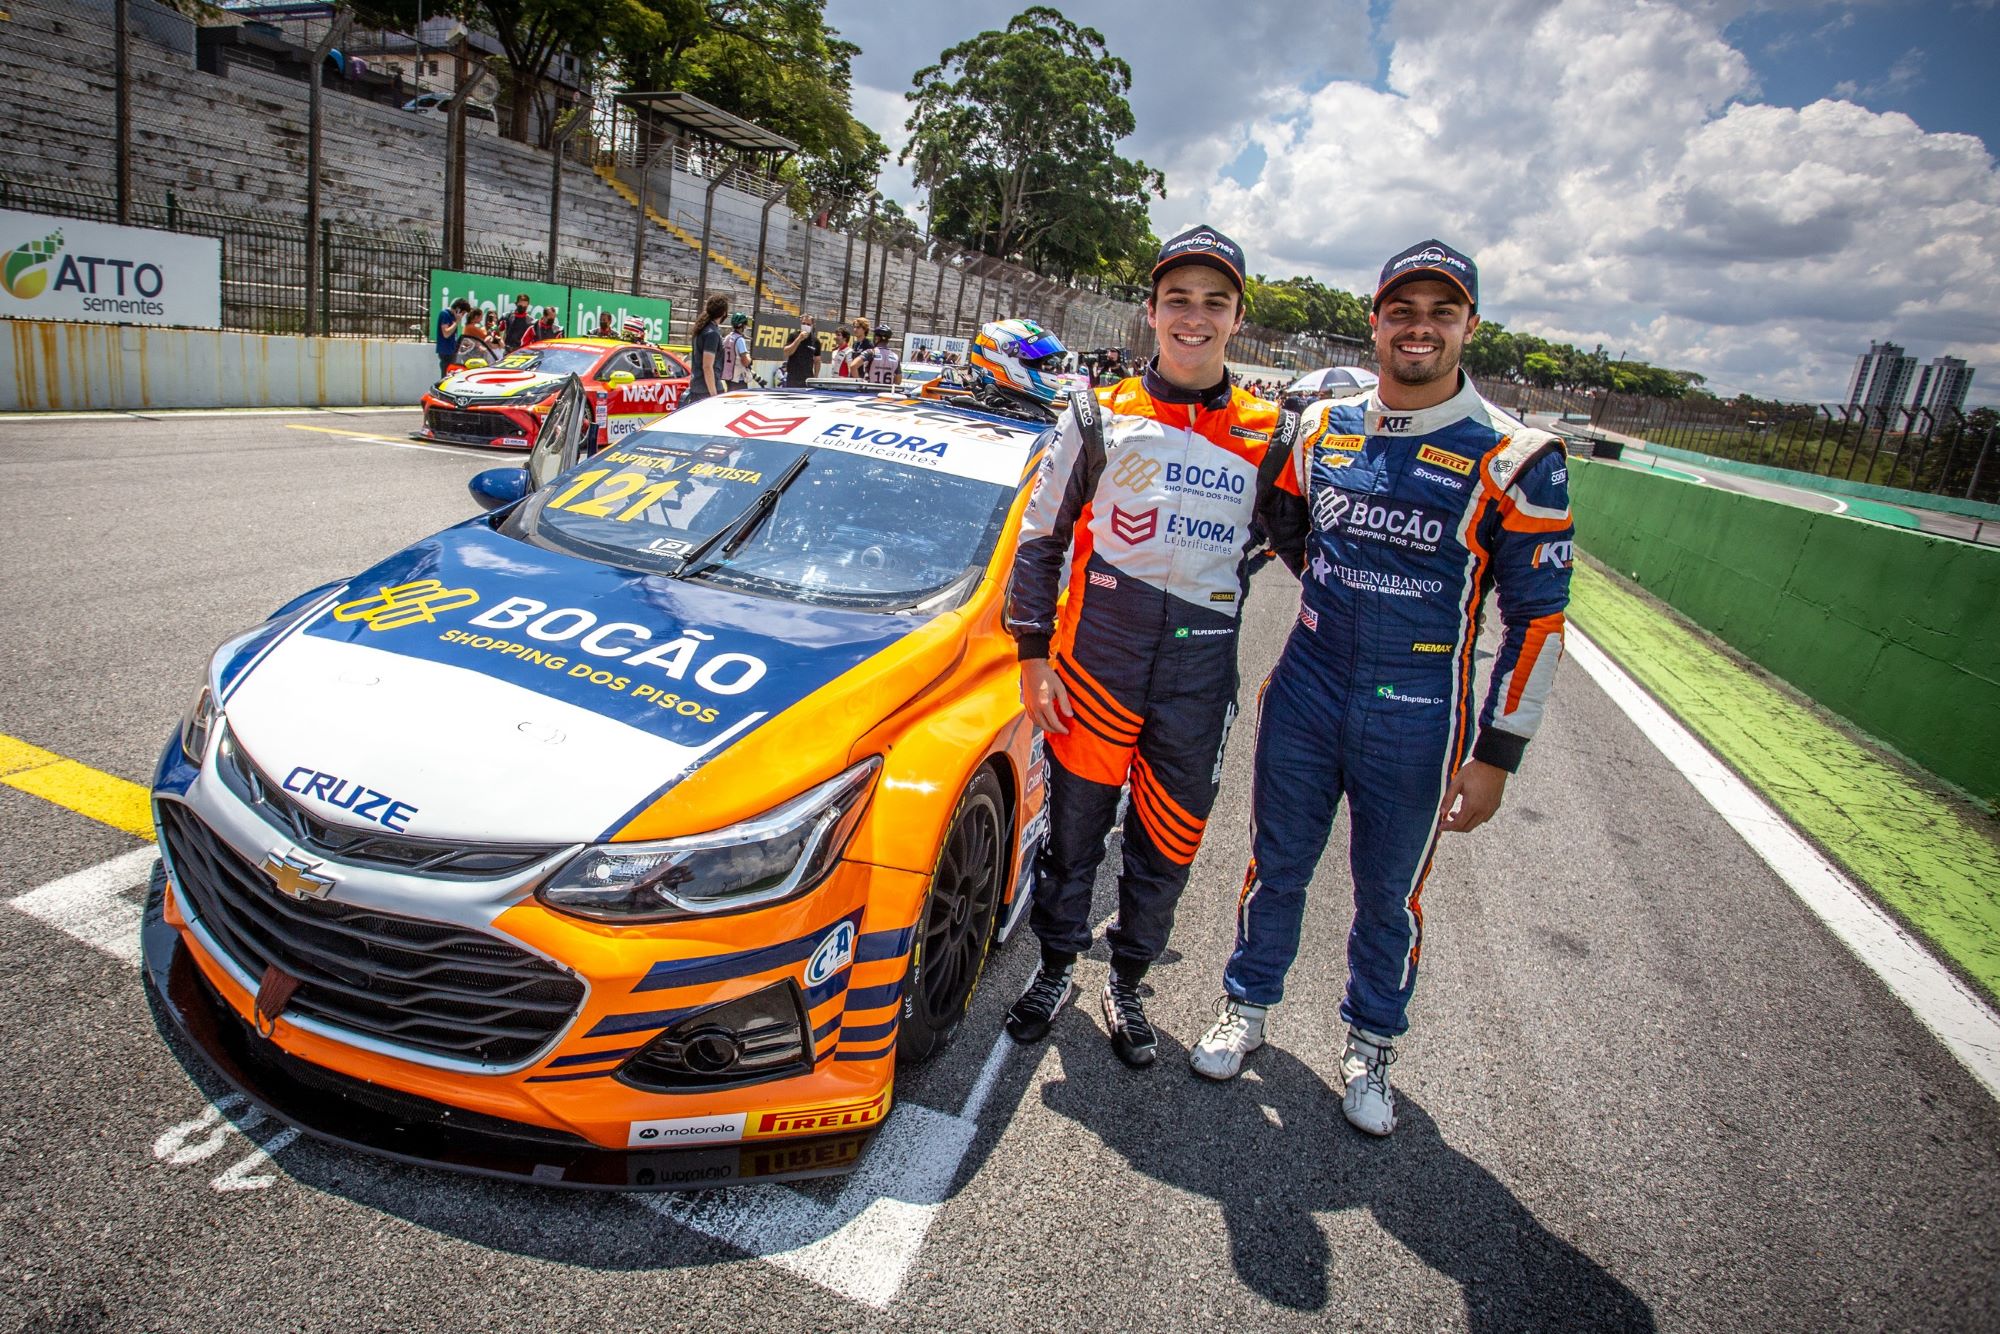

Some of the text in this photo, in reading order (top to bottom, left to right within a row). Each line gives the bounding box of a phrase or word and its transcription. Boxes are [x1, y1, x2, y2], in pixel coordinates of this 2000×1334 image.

[53, 254, 164, 298] ATTO
[83, 297, 164, 315] sementes
[874, 371, 892, 384] 16
[622, 384, 677, 404] MAXON
[610, 420, 637, 435] ideris
[1381, 415, 1413, 433] KTF
[812, 436, 939, 467] Lubrificantes
[821, 423, 949, 458] EVORA
[1325, 436, 1361, 448] PIRELLI
[604, 451, 674, 472] BAPTISTA
[687, 463, 763, 484] BAPTISTA
[1422, 447, 1470, 472] PIRELLI
[1166, 462, 1245, 495] BOCÃO
[547, 468, 681, 522] 121
[1164, 484, 1242, 505] SHOPPING DOS PISOS
[1167, 514, 1235, 544] EVORA
[1350, 501, 1443, 543] BOCÃO
[1164, 533, 1233, 555] Lubrificantes
[1346, 525, 1437, 552] SHOPPING DOS PISOS
[1333, 564, 1442, 593] ATHENABANCO
[1378, 585, 1423, 598] MERCANTIL
[1211, 593, 1234, 601] FREMAX
[468, 595, 768, 696] BOCÃO
[1412, 643, 1453, 653] FREMAX
[439, 629, 721, 724] SHOPPING DOS PISOS
[1401, 694, 1432, 704] Baptista
[282, 766, 419, 834] CRUZE
[757, 1091, 886, 1133] PIRELLI
[663, 1123, 735, 1137] motorola
